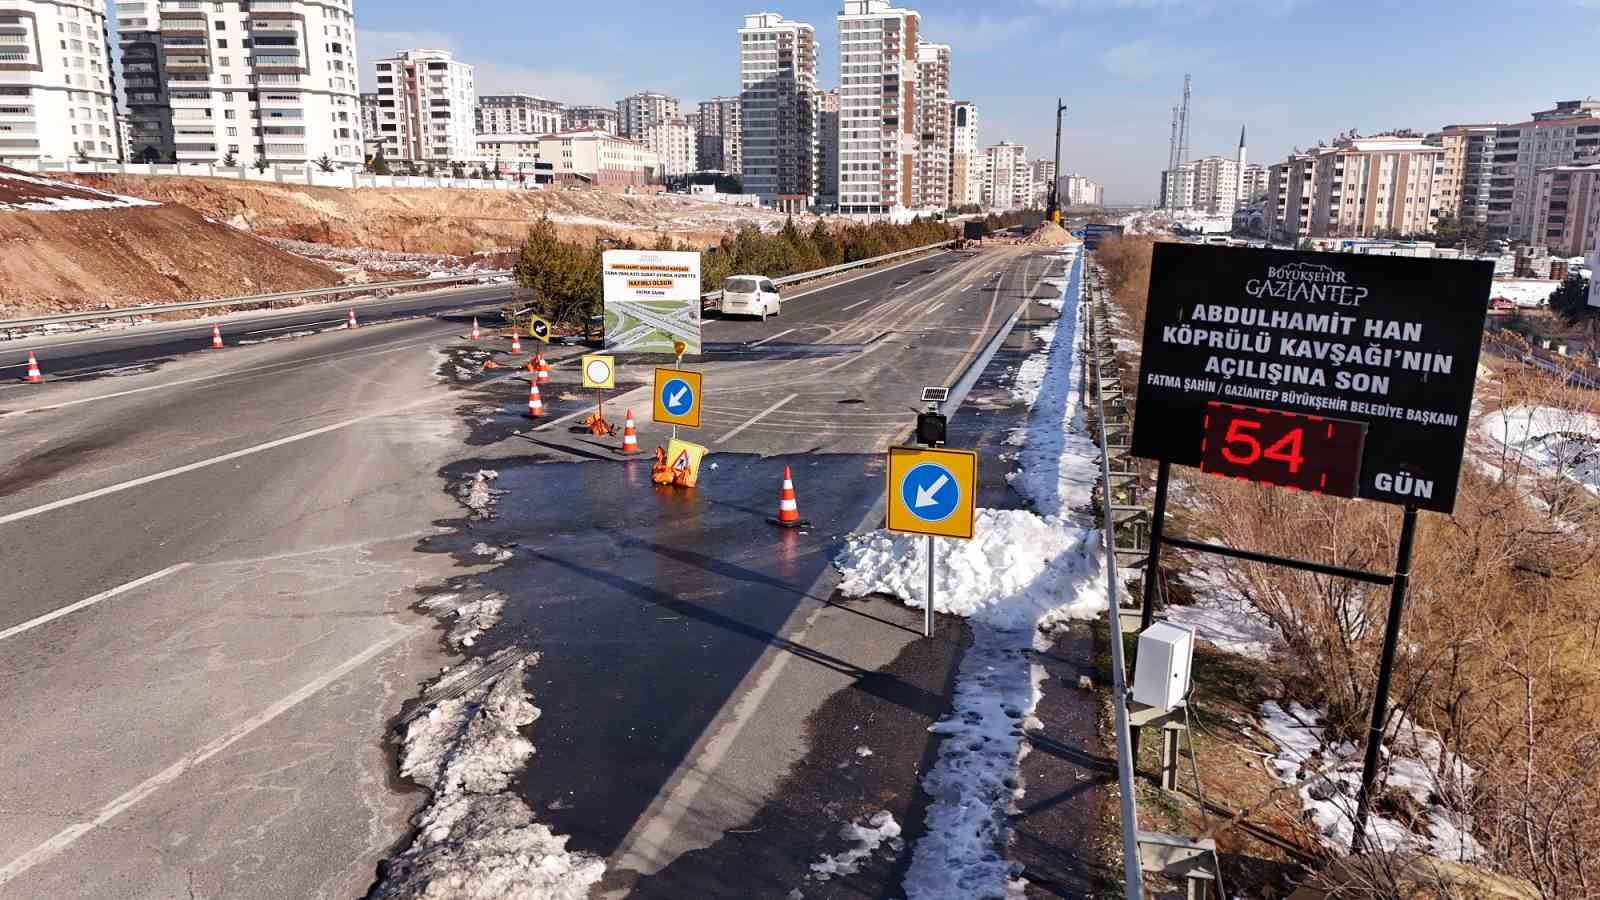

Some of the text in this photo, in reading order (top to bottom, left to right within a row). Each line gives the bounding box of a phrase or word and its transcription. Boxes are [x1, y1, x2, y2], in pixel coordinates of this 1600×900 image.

[1246, 278, 1369, 306] GAZİANTEP
[1192, 303, 1422, 342] ABDULHAMİT HAN
[1162, 323, 1453, 374] KÖPRÜLÜ KAVŞAĞI'NIN
[1204, 355, 1390, 395] AÇILIŞINA SON
[1147, 373, 1181, 389] FATMA
[1184, 377, 1216, 393] ŞAHİN
[1224, 383, 1279, 401] GAZİANTEP
[1281, 390, 1348, 411] BÜYÜKŞEHİR
[1350, 401, 1403, 420] BELEDİYE
[1406, 408, 1458, 427] BAŞKANI
[1221, 418, 1305, 473] 54
[1374, 471, 1434, 499] GÜN
